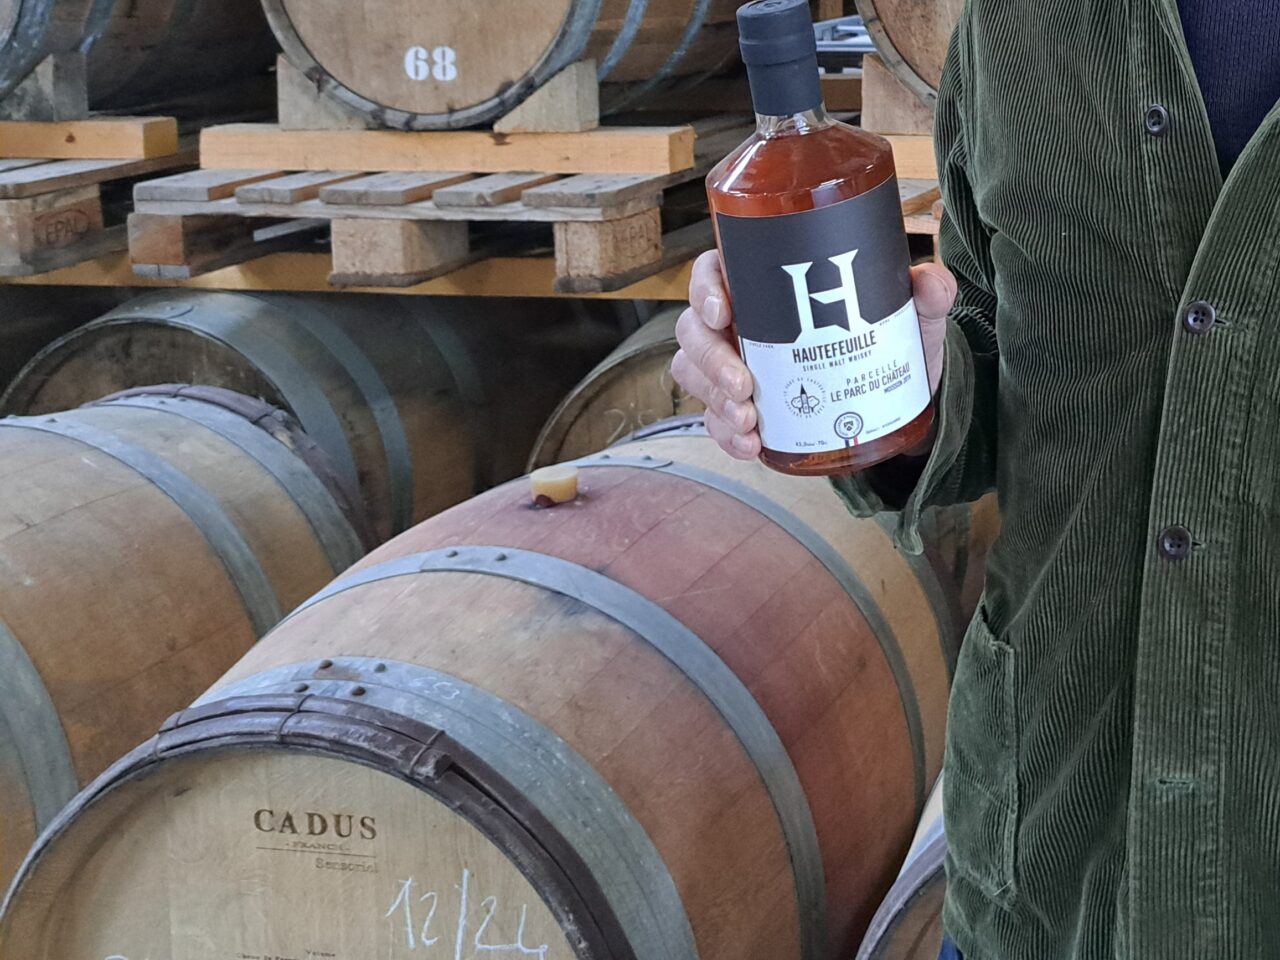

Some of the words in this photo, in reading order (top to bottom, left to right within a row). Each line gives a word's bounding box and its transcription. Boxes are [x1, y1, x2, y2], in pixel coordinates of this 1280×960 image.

[404, 45, 458, 81] 68
[781, 248, 872, 344] H
[792, 330, 877, 364] HAUTEFEUILLE
[802, 362, 826, 373] SINGLE
[829, 357, 846, 368] MALT
[848, 349, 872, 363] WHISKY
[846, 359, 898, 386] PARCELLE
[830, 390, 843, 403] LE
[843, 383, 867, 400] PARC
[868, 378, 881, 392] DU
[254, 808, 377, 840] CADUS
